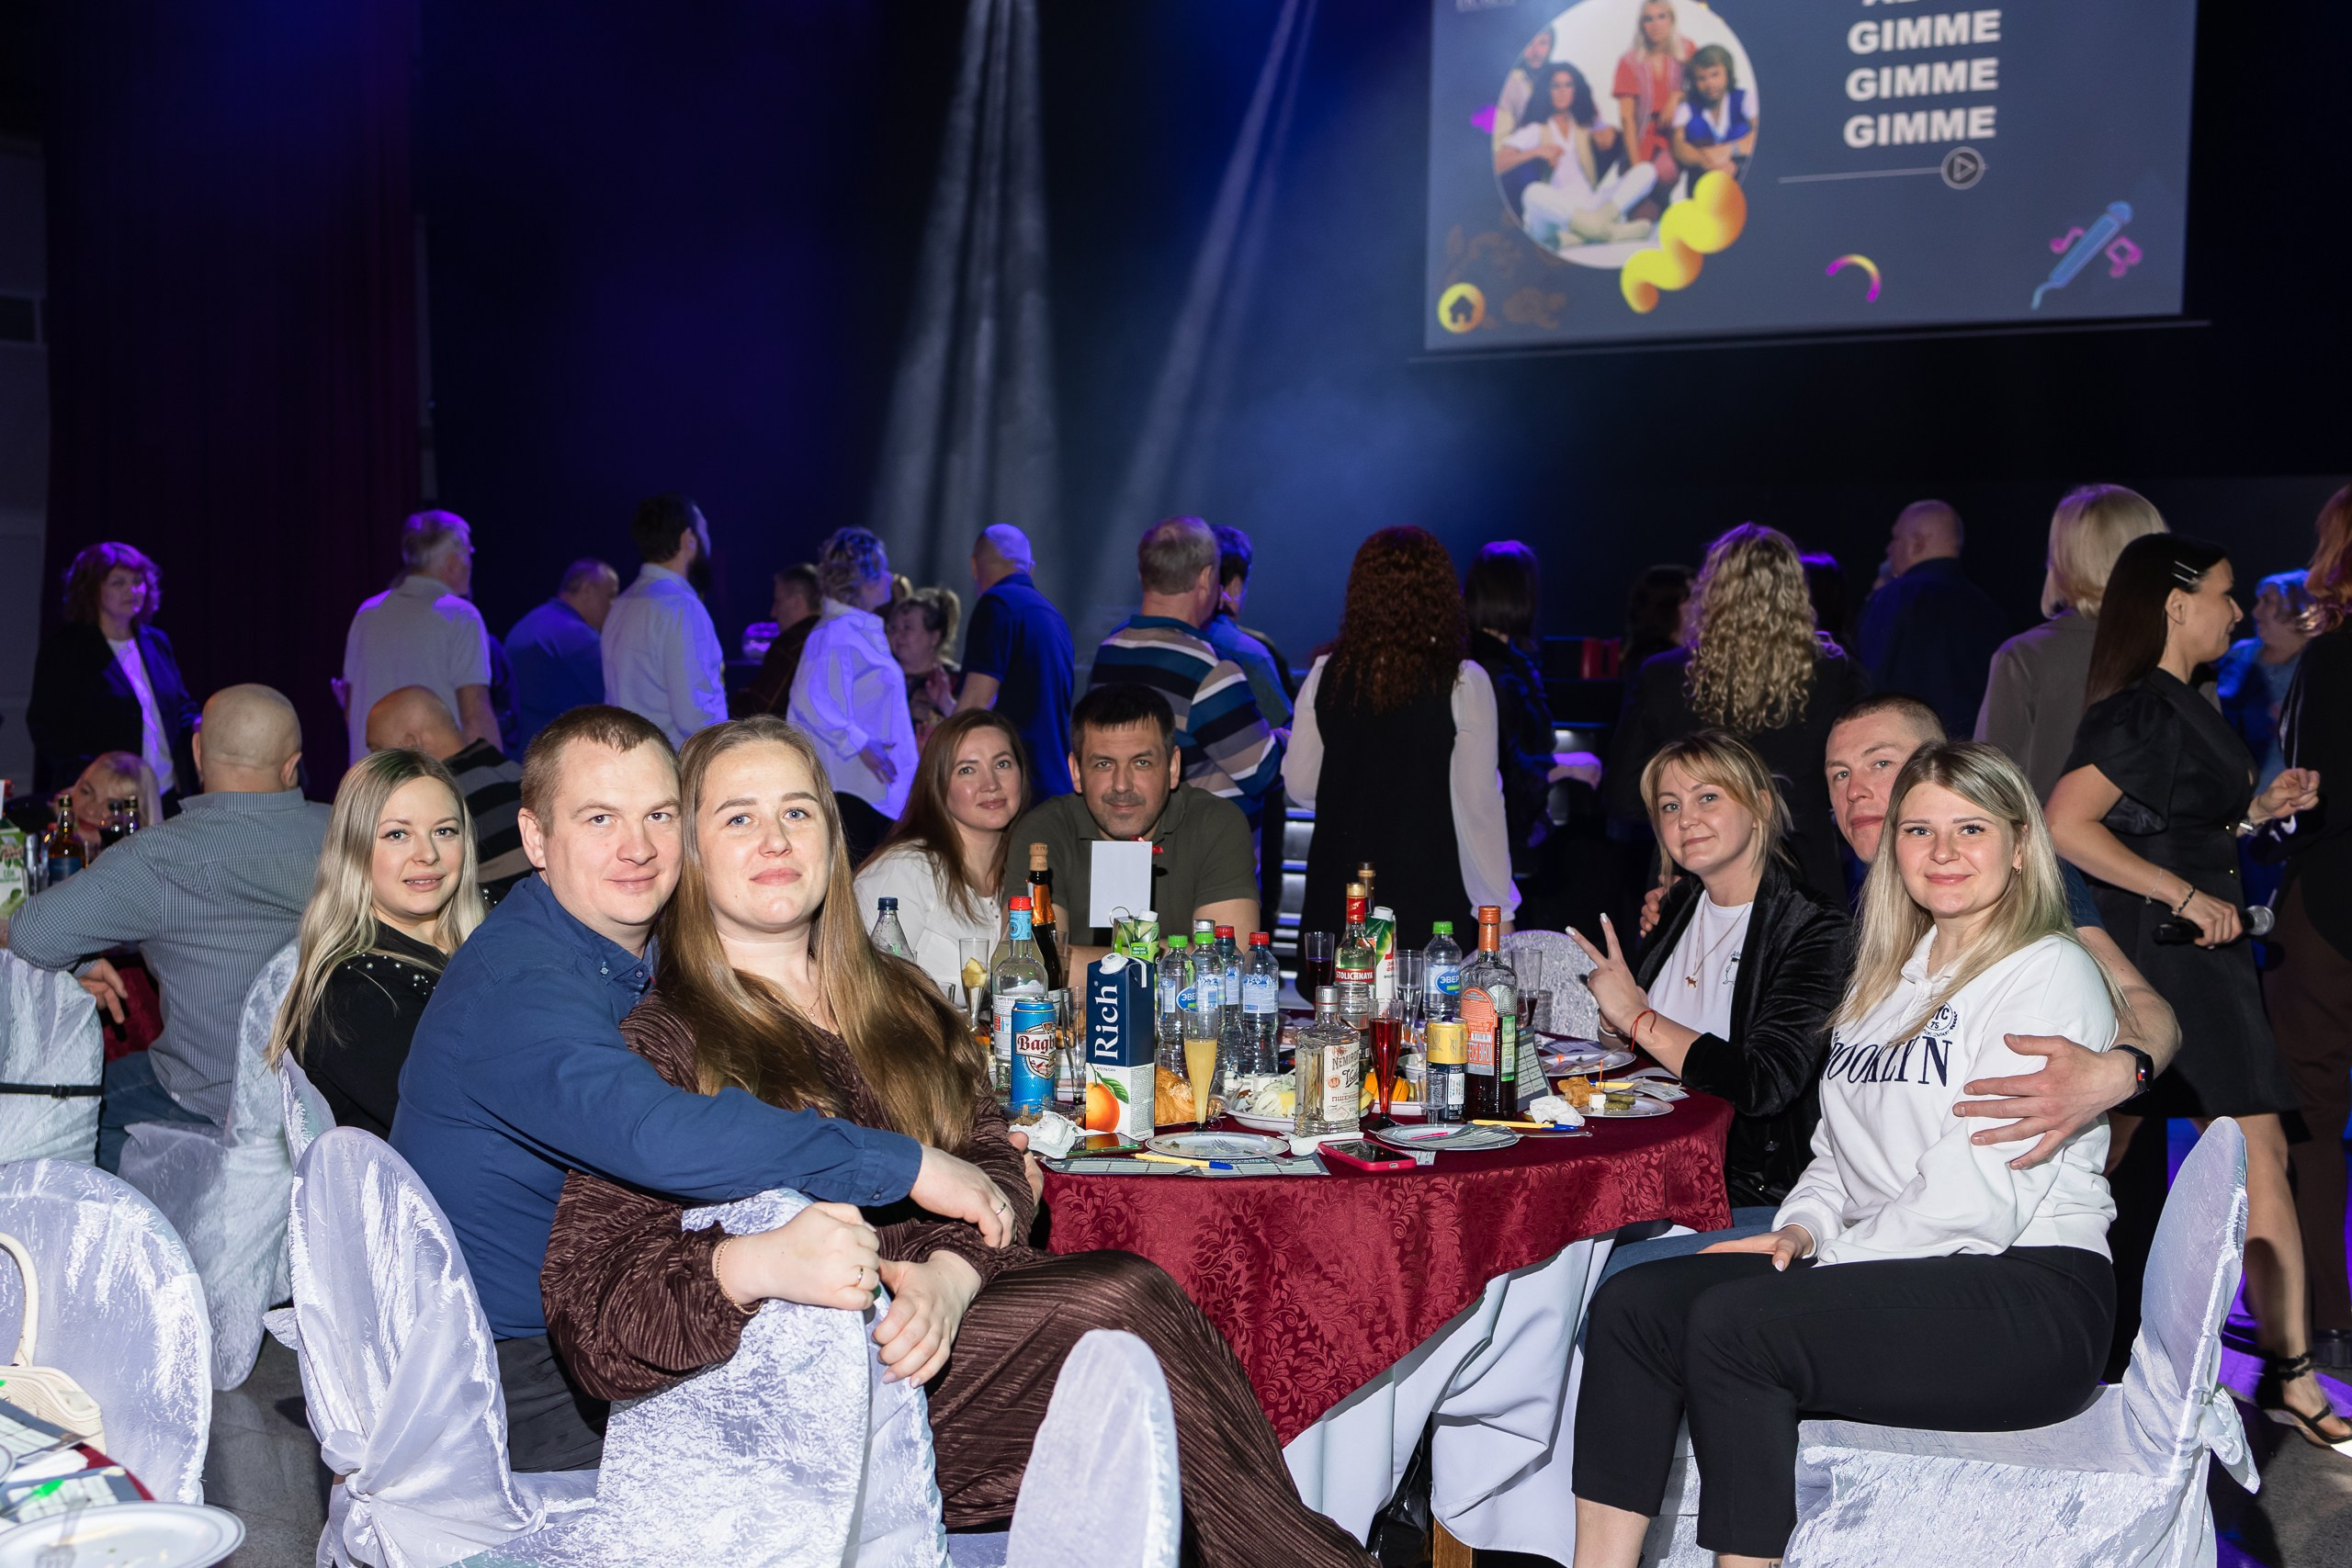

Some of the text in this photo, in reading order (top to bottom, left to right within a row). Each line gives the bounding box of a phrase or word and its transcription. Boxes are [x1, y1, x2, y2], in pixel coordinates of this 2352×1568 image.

[1848, 9, 2002, 55] GIMME
[1845, 57, 1999, 102] GIMME
[1843, 106, 1997, 149] GIMME
[1336, 971, 1374, 981] STOLICHNAYA
[1094, 984, 1119, 1060] Rich
[1932, 1004, 1950, 1021] YC
